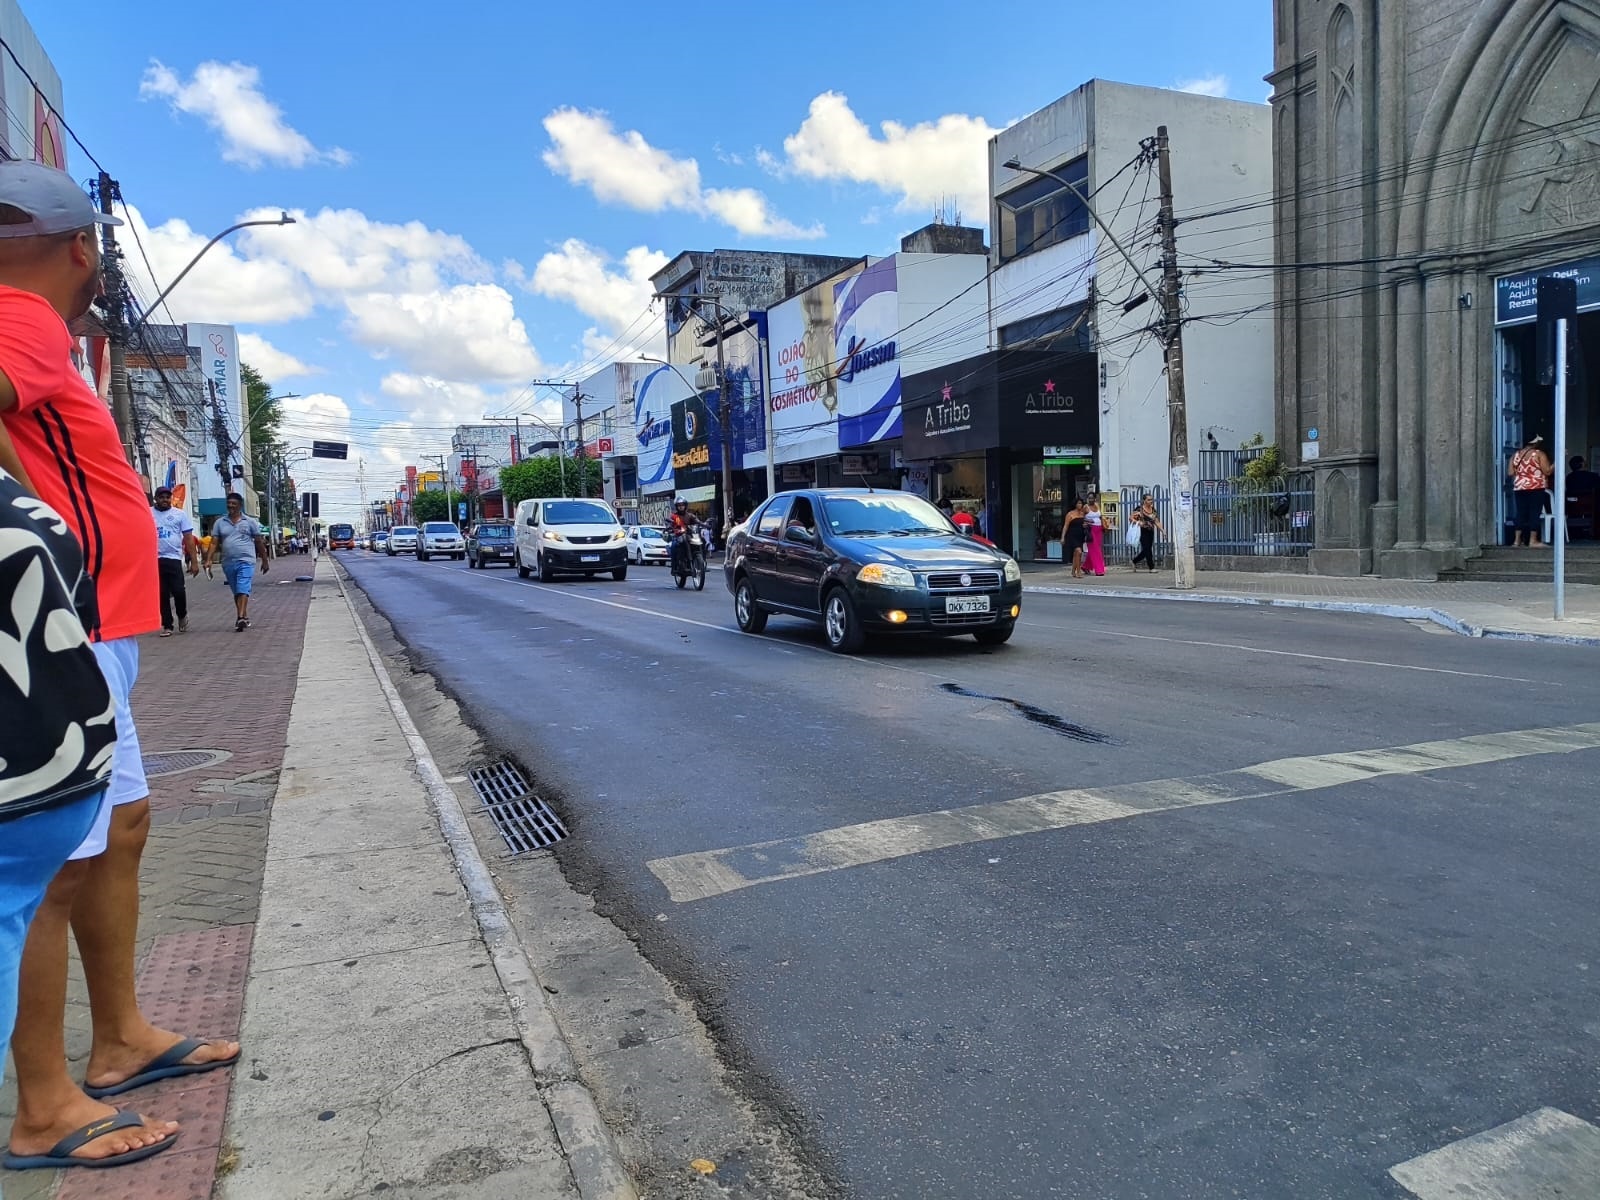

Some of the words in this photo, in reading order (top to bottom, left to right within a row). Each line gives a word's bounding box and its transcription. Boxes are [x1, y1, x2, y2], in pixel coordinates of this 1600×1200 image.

[1552, 268, 1579, 279] Deus
[1509, 277, 1530, 290] Aqui
[1509, 288, 1530, 300] Aqui
[1509, 298, 1538, 310] Rezan
[213, 359, 227, 397] AMAR
[785, 366, 799, 384] DO
[1025, 393, 1036, 407] A
[1039, 391, 1074, 407] Tribo
[925, 407, 934, 429] A
[936, 399, 971, 426] Tribo
[1037, 489, 1044, 503] A
[966, 601, 988, 612] 7326
